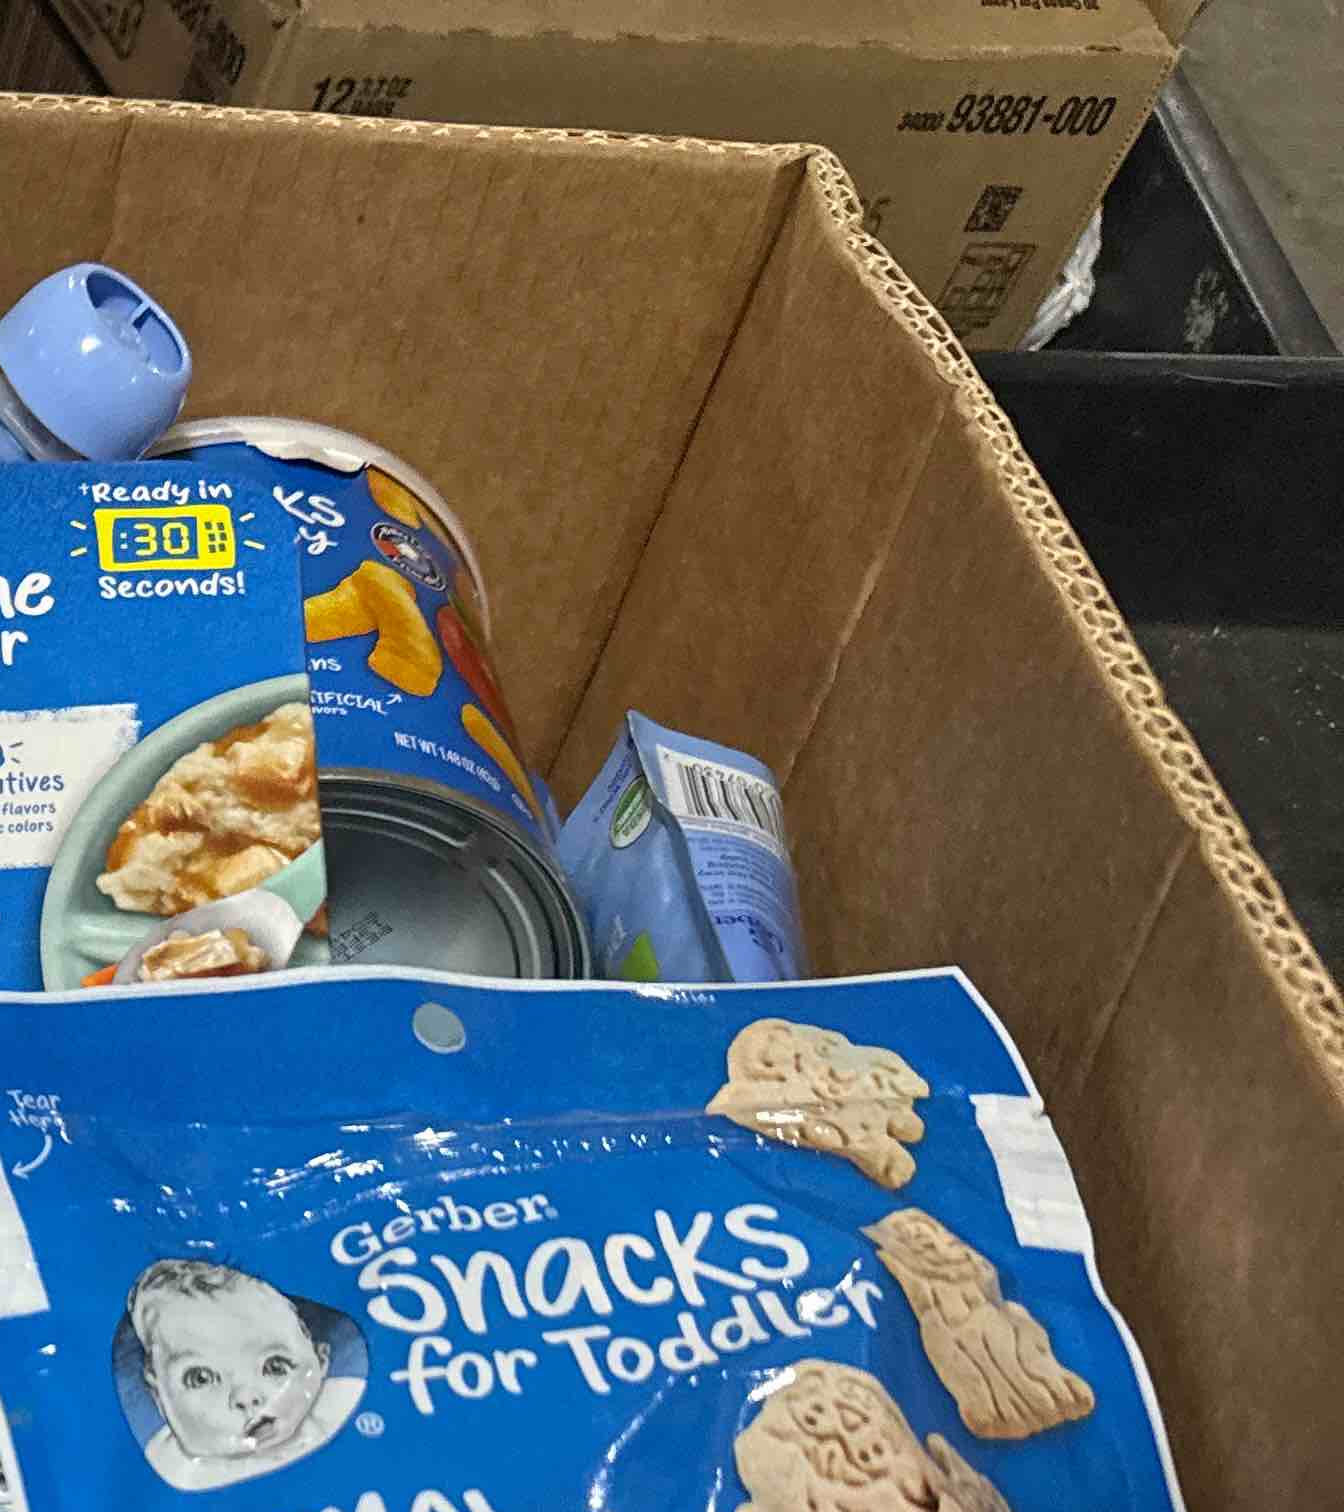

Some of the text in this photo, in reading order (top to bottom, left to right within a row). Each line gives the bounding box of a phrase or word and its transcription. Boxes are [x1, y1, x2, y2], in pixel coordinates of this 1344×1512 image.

[946, 94, 1117, 136] 93881-000
[198, 480, 232, 498] in
[98, 571, 246, 598] Seconds!
[1, 801, 57, 819] flavors
[10, 818, 54, 836] colors
[8, 1089, 61, 1113] Tear
[330, 1191, 557, 1268] Gerber
[359, 1204, 810, 1337] Snacks
[391, 1258, 883, 1414] for Toddler
